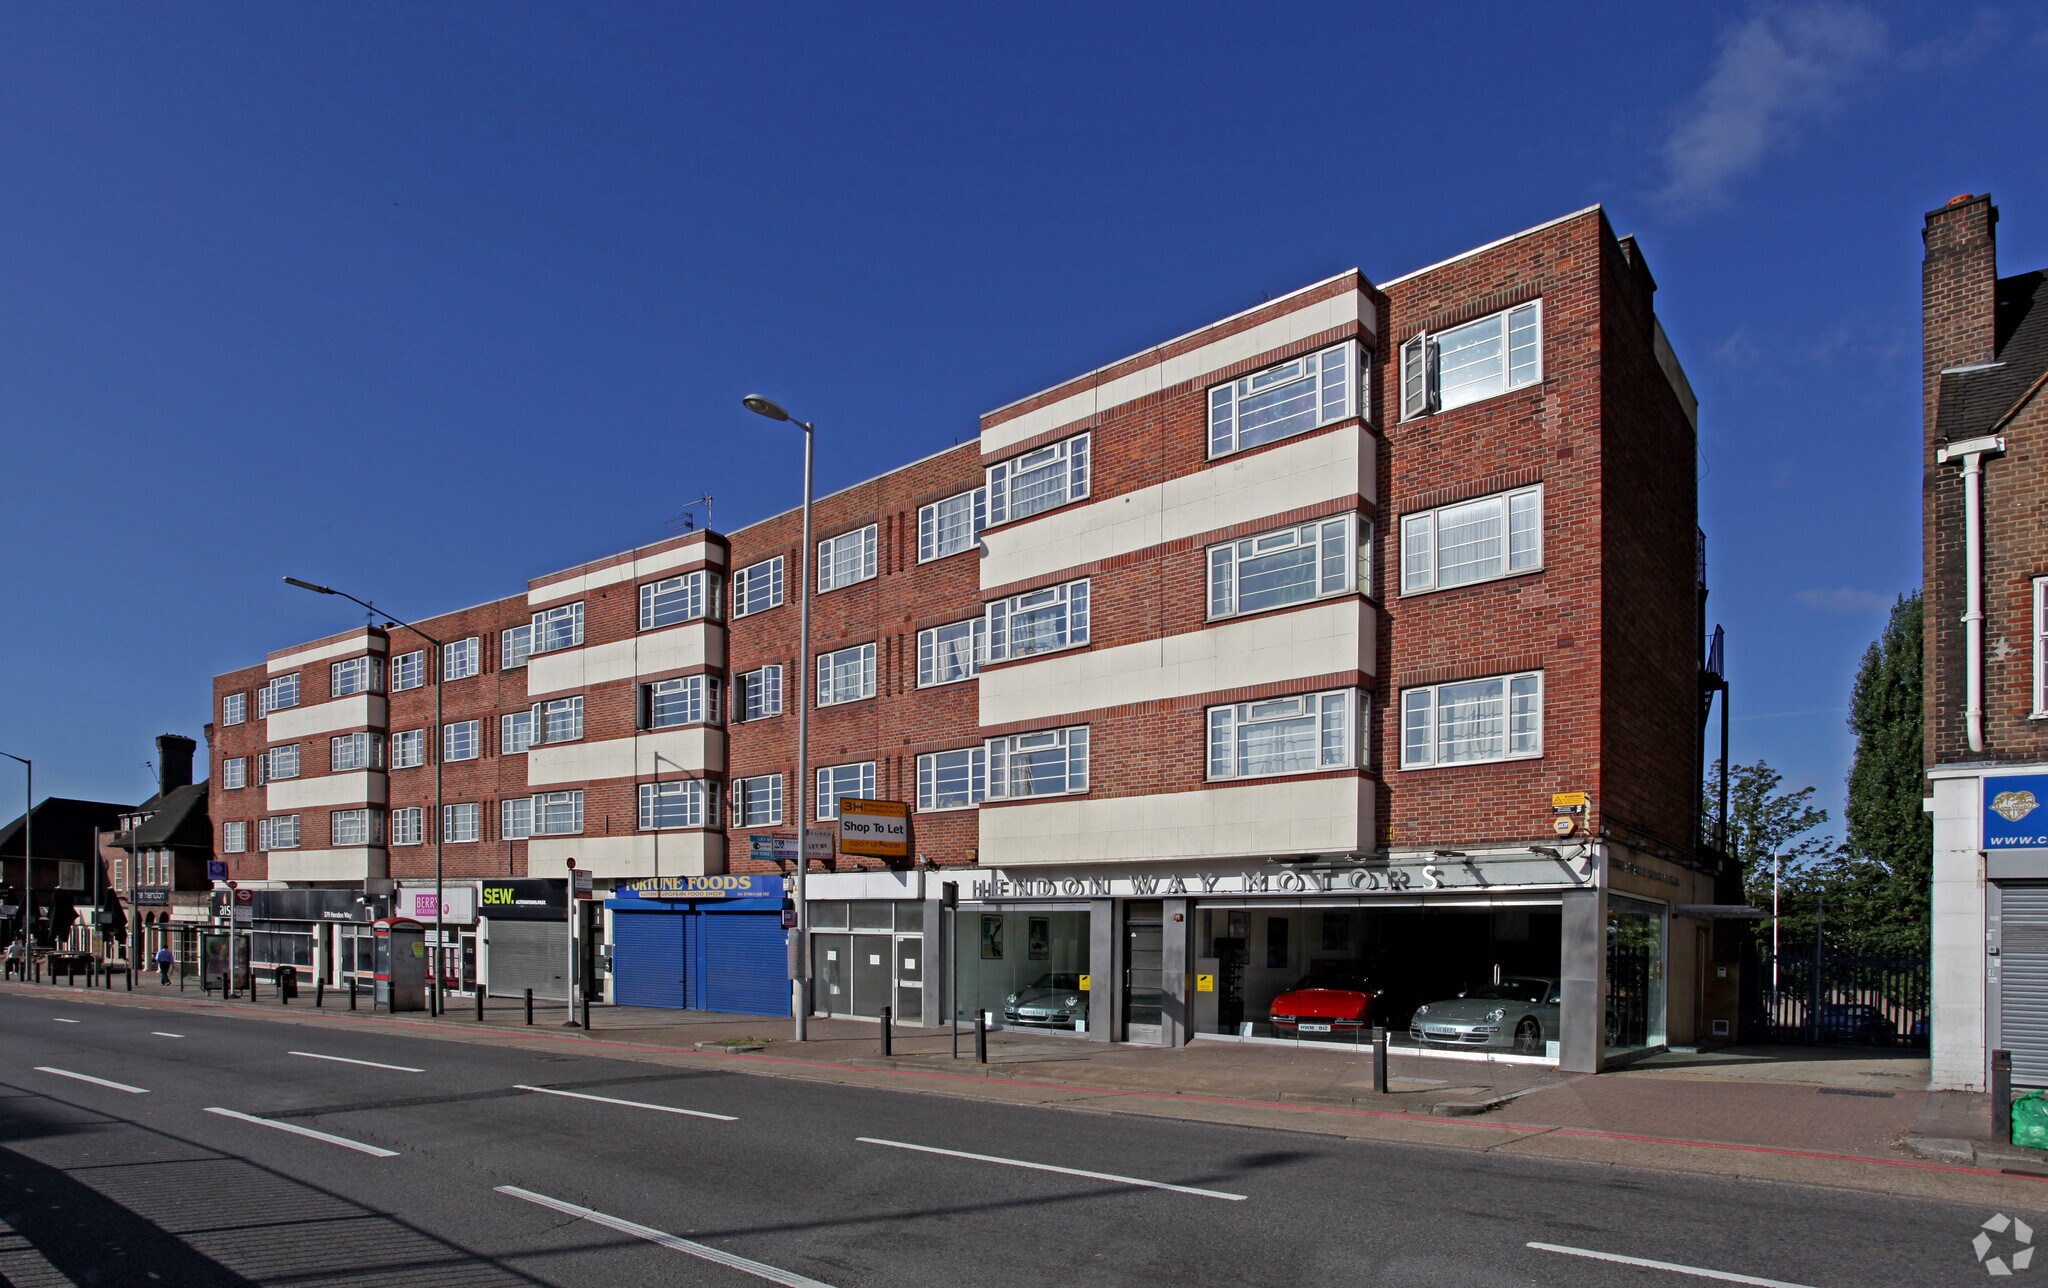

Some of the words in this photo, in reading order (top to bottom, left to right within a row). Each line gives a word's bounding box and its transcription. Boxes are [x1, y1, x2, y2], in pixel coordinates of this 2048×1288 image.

[844, 821, 870, 834] Shop
[873, 823, 884, 833] To
[888, 824, 904, 834] Let
[625, 876, 683, 891] FORTUNE
[688, 876, 751, 890] FOODS
[972, 876, 1106, 898] HENDON
[1129, 873, 1213, 895] WAY
[1241, 865, 1438, 893] MOTORS
[144, 890, 165, 899] hendon
